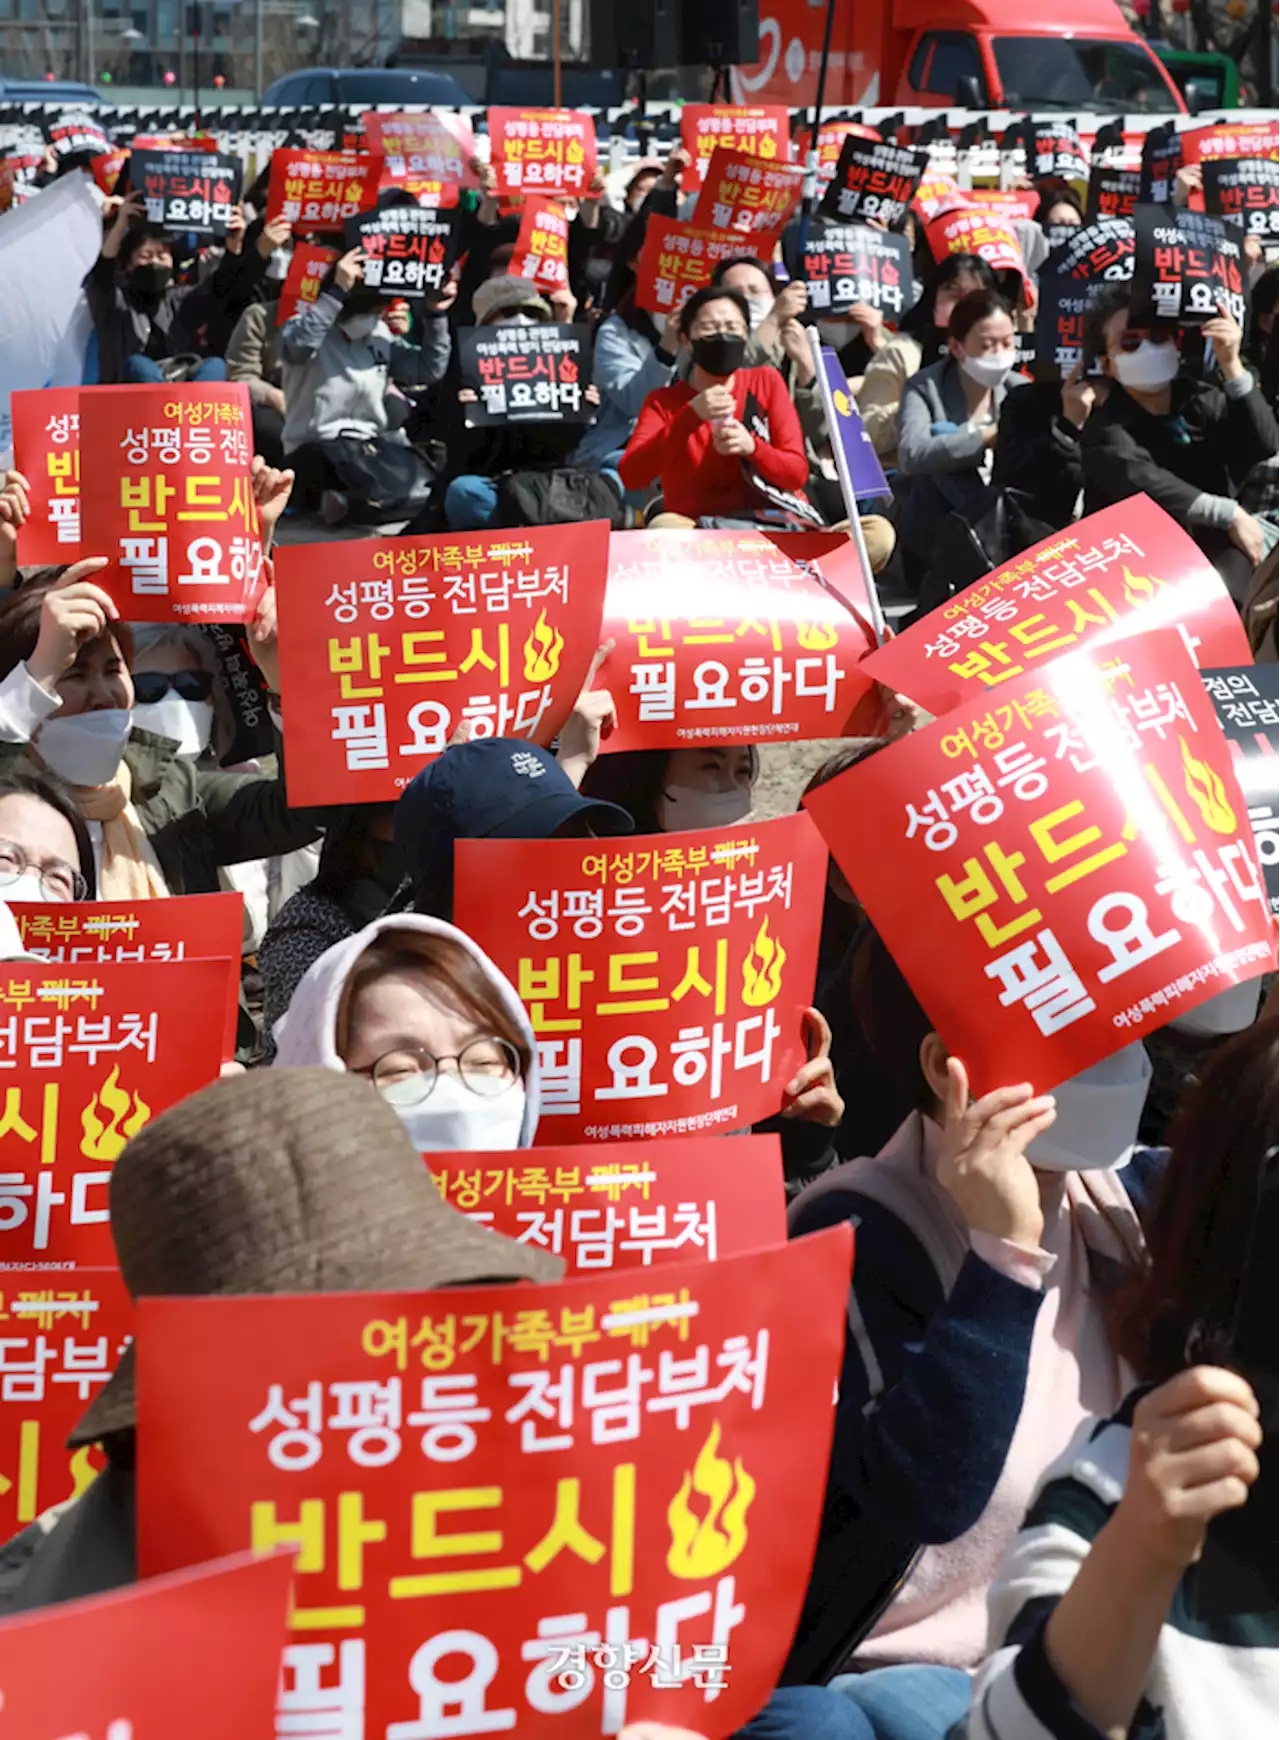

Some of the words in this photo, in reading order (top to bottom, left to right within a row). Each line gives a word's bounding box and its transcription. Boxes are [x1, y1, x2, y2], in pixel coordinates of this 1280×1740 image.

[503, 162, 585, 188] 필요하다
[504, 138, 563, 163] 반드시
[145, 175, 210, 203] 반드시
[285, 179, 344, 201] 반드시
[846, 165, 904, 201] 반드시
[144, 196, 233, 226] 필요하다
[361, 233, 428, 262] 반드시
[804, 252, 878, 283] 반드시
[1154, 246, 1229, 289] 반드시
[363, 259, 445, 290] 필요하다
[806, 278, 904, 313] 필요하다
[478, 354, 556, 384] 반드시
[480, 381, 582, 414] 필요하다
[120, 427, 215, 465] 성평등
[373, 547, 487, 576] 여성가족부
[325, 577, 436, 623] 성평등
[443, 565, 569, 614] 전담부처
[924, 596, 1019, 659] 성평등
[1012, 532, 1146, 602] 전담부처
[943, 560, 1038, 620] 여성가족부
[328, 623, 509, 699] 반드시
[947, 588, 1121, 687] 반드시
[629, 654, 845, 721] 필요하다
[331, 684, 552, 771] 필요하다
[904, 741, 1048, 851] 성평등
[582, 846, 710, 883] 여성가족부
[518, 887, 652, 940] 성평등
[660, 862, 793, 931] 전담부처
[984, 839, 1272, 1037] 필요하다
[518, 938, 728, 1032] 반드시
[534, 1008, 780, 1115] 필요하다
[362, 1305, 599, 1371] 여성가족부
[249, 1370, 490, 1470] 성평등
[506, 1328, 769, 1452] 전담부처
[250, 1463, 636, 1630] 반드시
[275, 1575, 745, 1740] 필요하다
